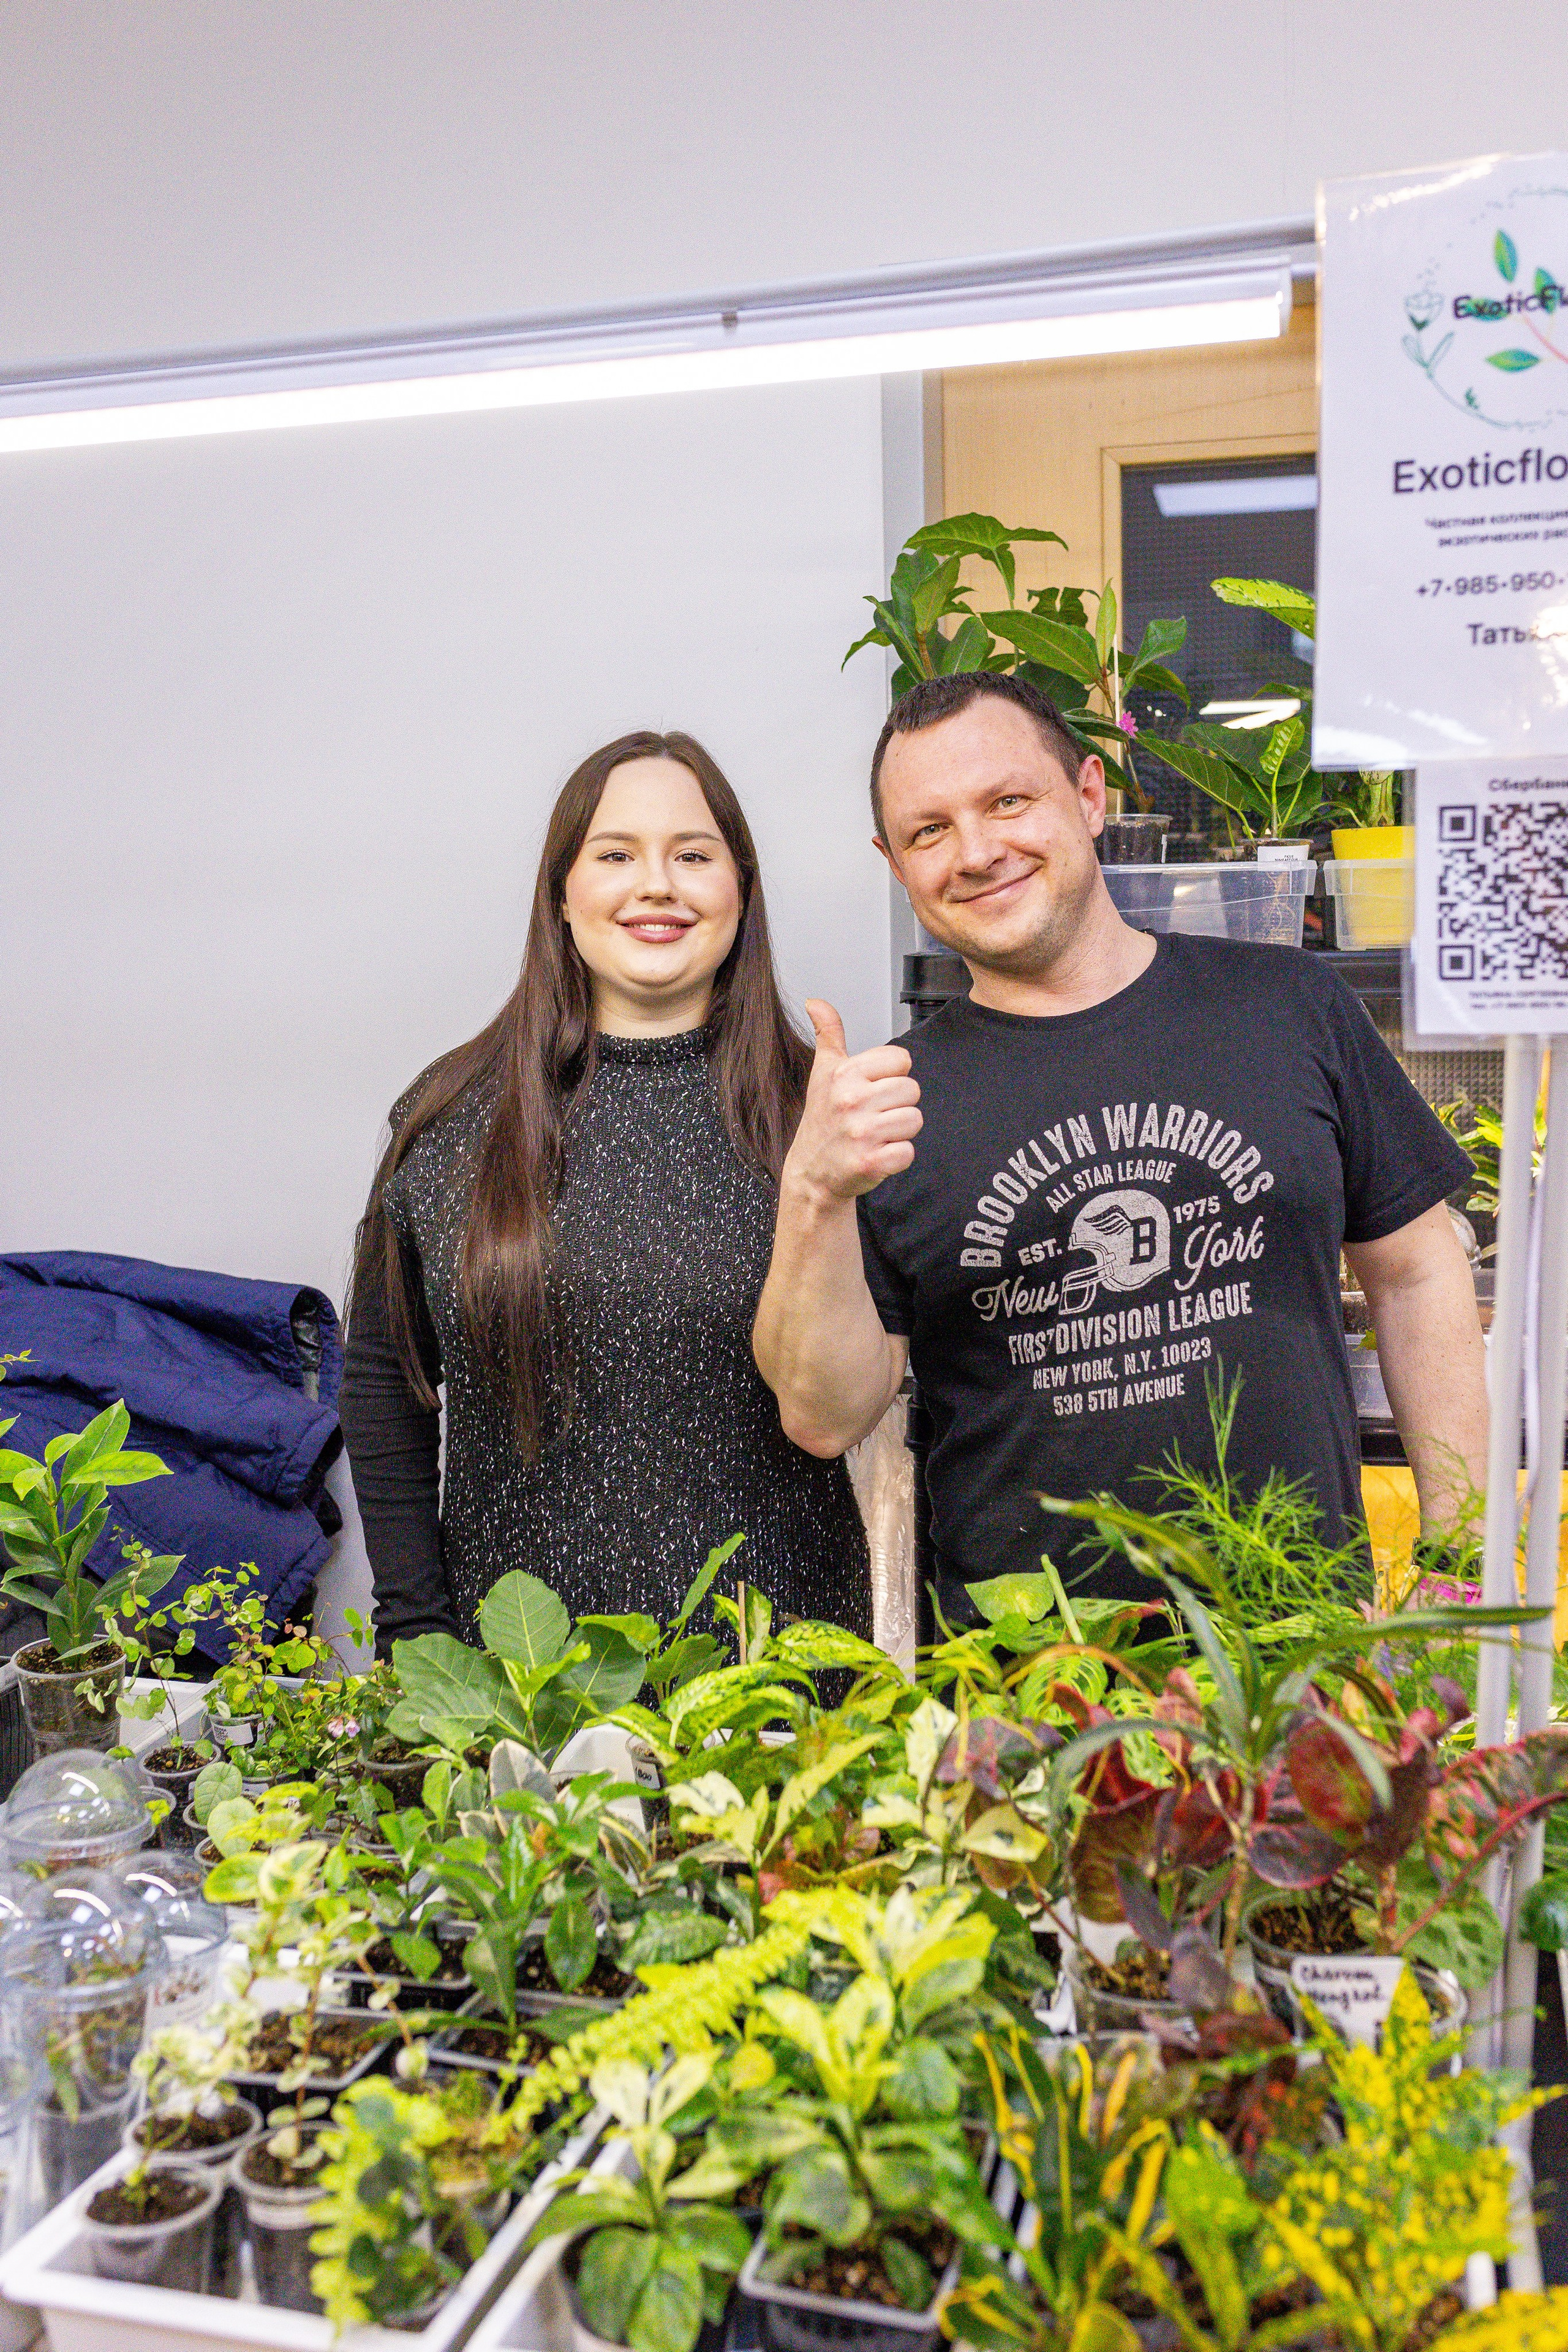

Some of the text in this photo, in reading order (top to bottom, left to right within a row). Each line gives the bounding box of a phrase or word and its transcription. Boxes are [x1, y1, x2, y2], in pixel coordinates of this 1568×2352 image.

[1393, 448, 1568, 494] Exoticflo
[960, 1102, 1274, 1267] BROOKLYN WARRIORS
[1046, 1159, 1177, 1213] ALL STAR LEAGUE
[1018, 1196, 1220, 1266] EST. 1975
[971, 1215, 1264, 1321] New York
[1055, 1303, 1161, 1355] DIVISION
[1168, 1281, 1253, 1332] LEAGUE
[1033, 1336, 1212, 1390] NEW YORK, N.Y. 10023
[1053, 1373, 1185, 1416] 538 5TH AVENUE
